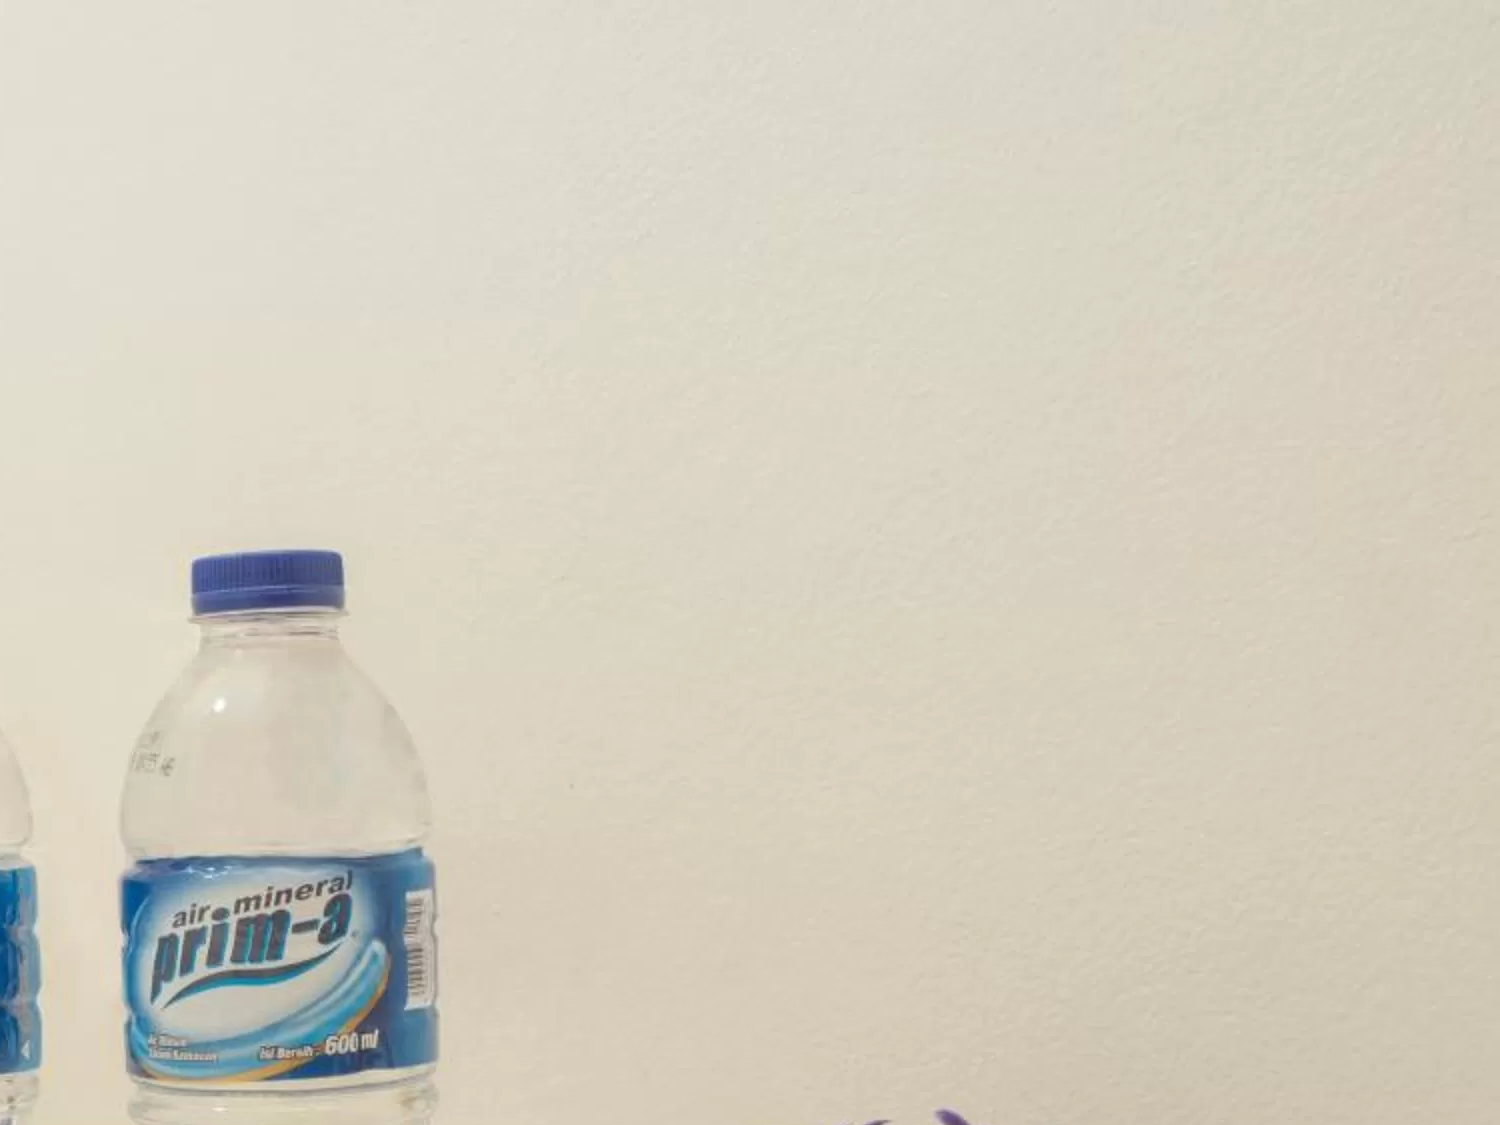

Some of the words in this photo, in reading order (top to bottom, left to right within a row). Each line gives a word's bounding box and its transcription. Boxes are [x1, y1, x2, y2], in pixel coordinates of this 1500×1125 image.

[171, 902, 210, 929] air
[233, 870, 354, 916] mineral
[150, 893, 354, 1007] prim-a
[325, 1031, 359, 1056] 600
[361, 1028, 379, 1050] ml
